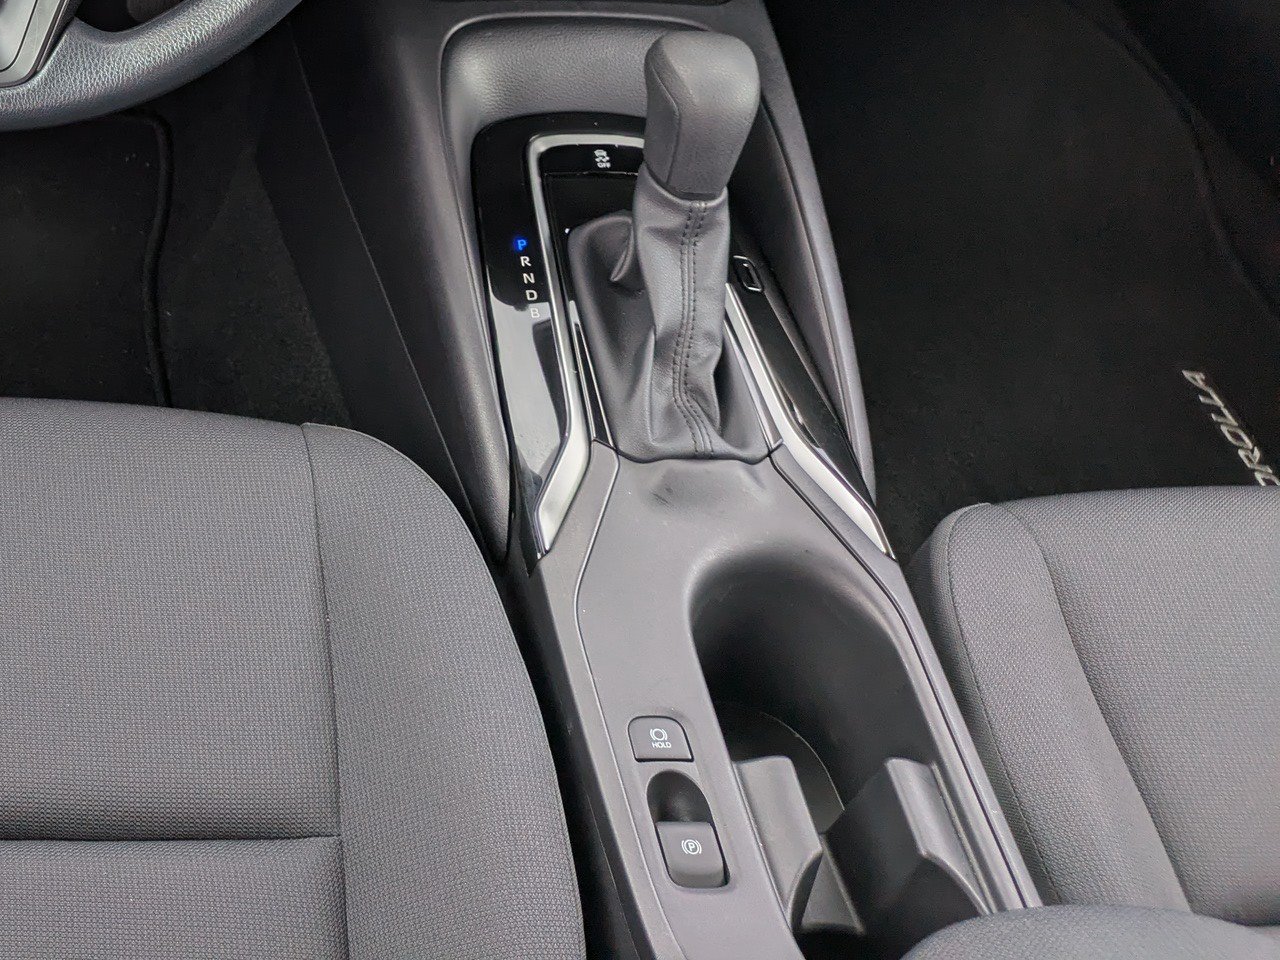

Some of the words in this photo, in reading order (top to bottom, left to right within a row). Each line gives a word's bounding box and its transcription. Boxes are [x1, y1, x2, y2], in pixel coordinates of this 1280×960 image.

[518, 239, 527, 250] P
[520, 256, 532, 267] R
[523, 273, 535, 284] N
[525, 289, 538, 300] D
[530, 307, 540, 318] B
